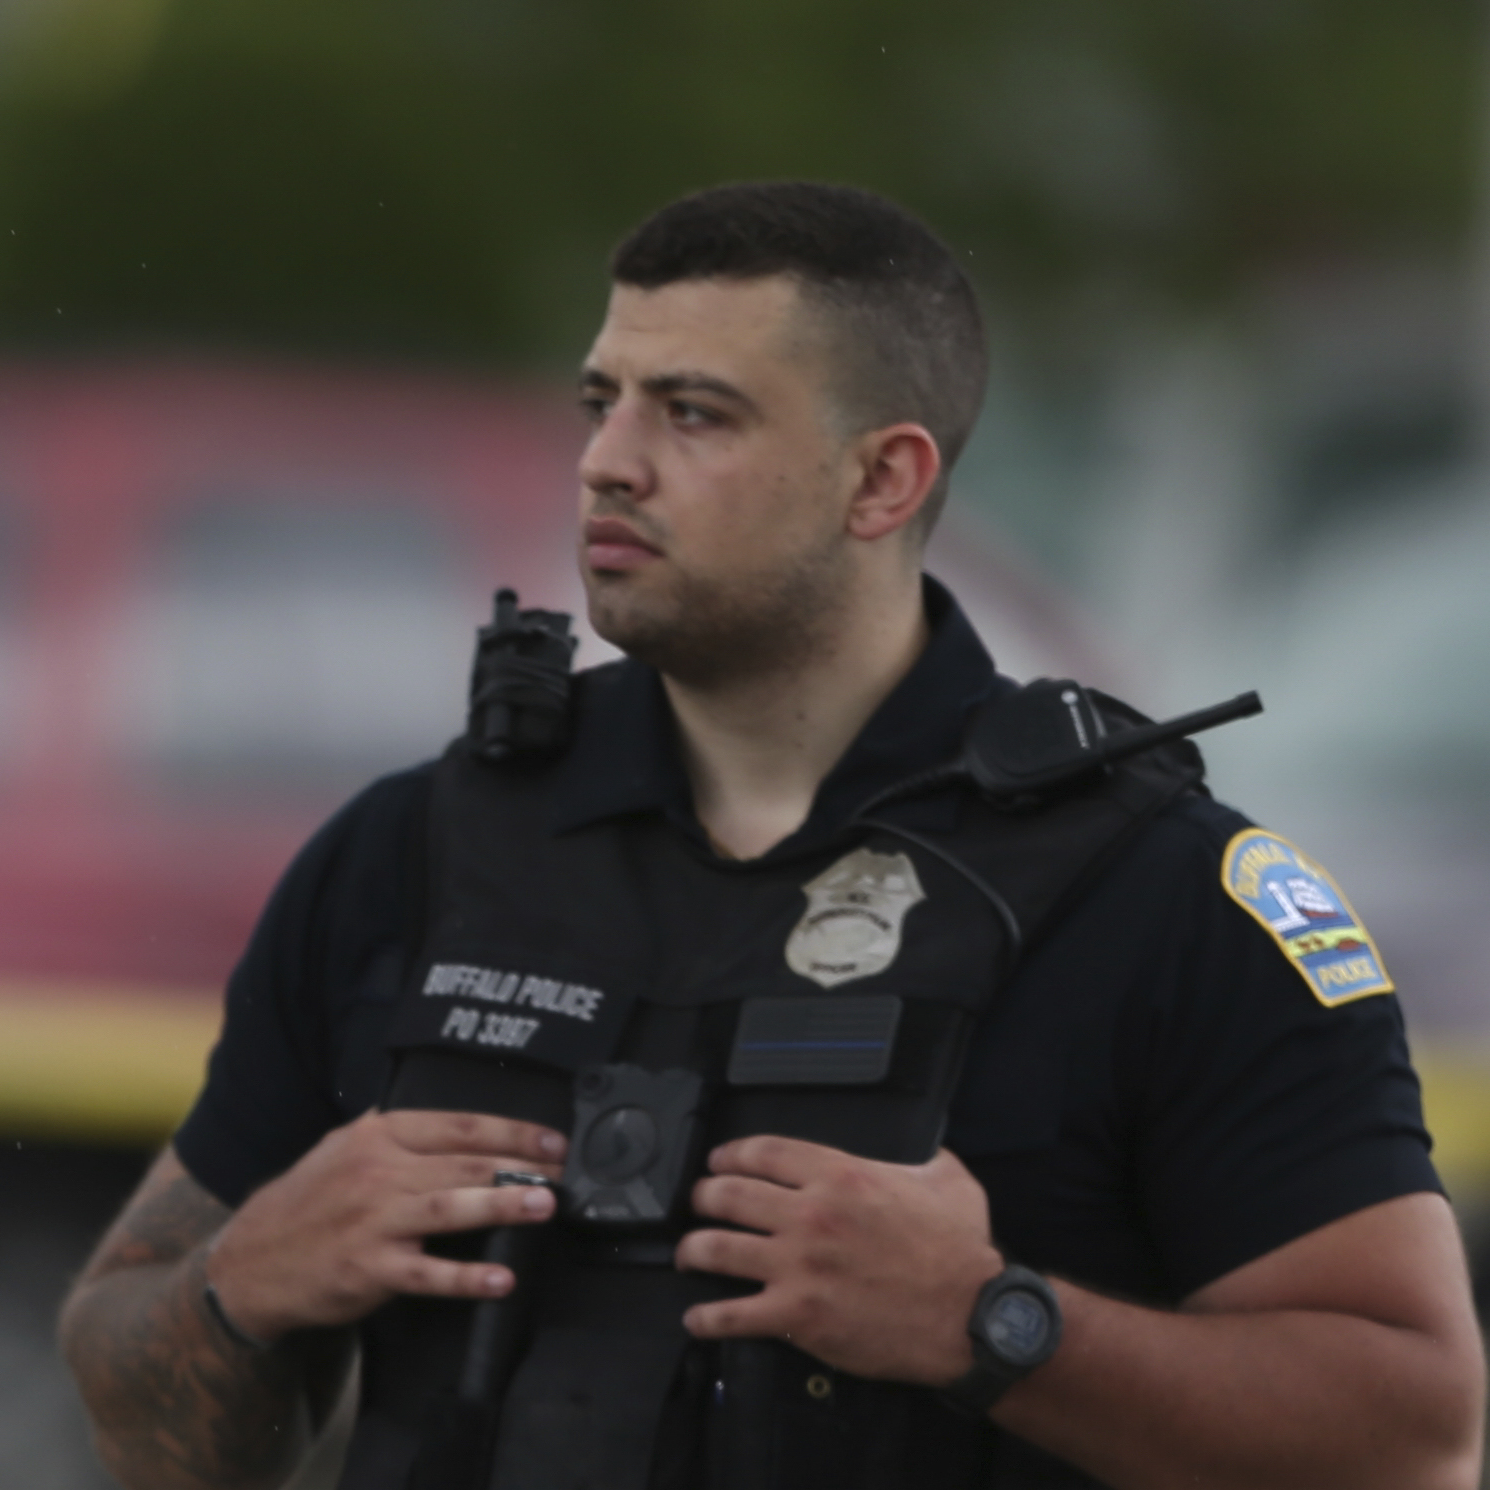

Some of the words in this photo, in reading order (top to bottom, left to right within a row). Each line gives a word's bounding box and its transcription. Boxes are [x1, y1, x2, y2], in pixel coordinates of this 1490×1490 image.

[1316, 956, 1379, 990] POLICE
[422, 963, 521, 1004] BUFFALO
[515, 973, 605, 1022] POLICE
[440, 1005, 481, 1041] PO
